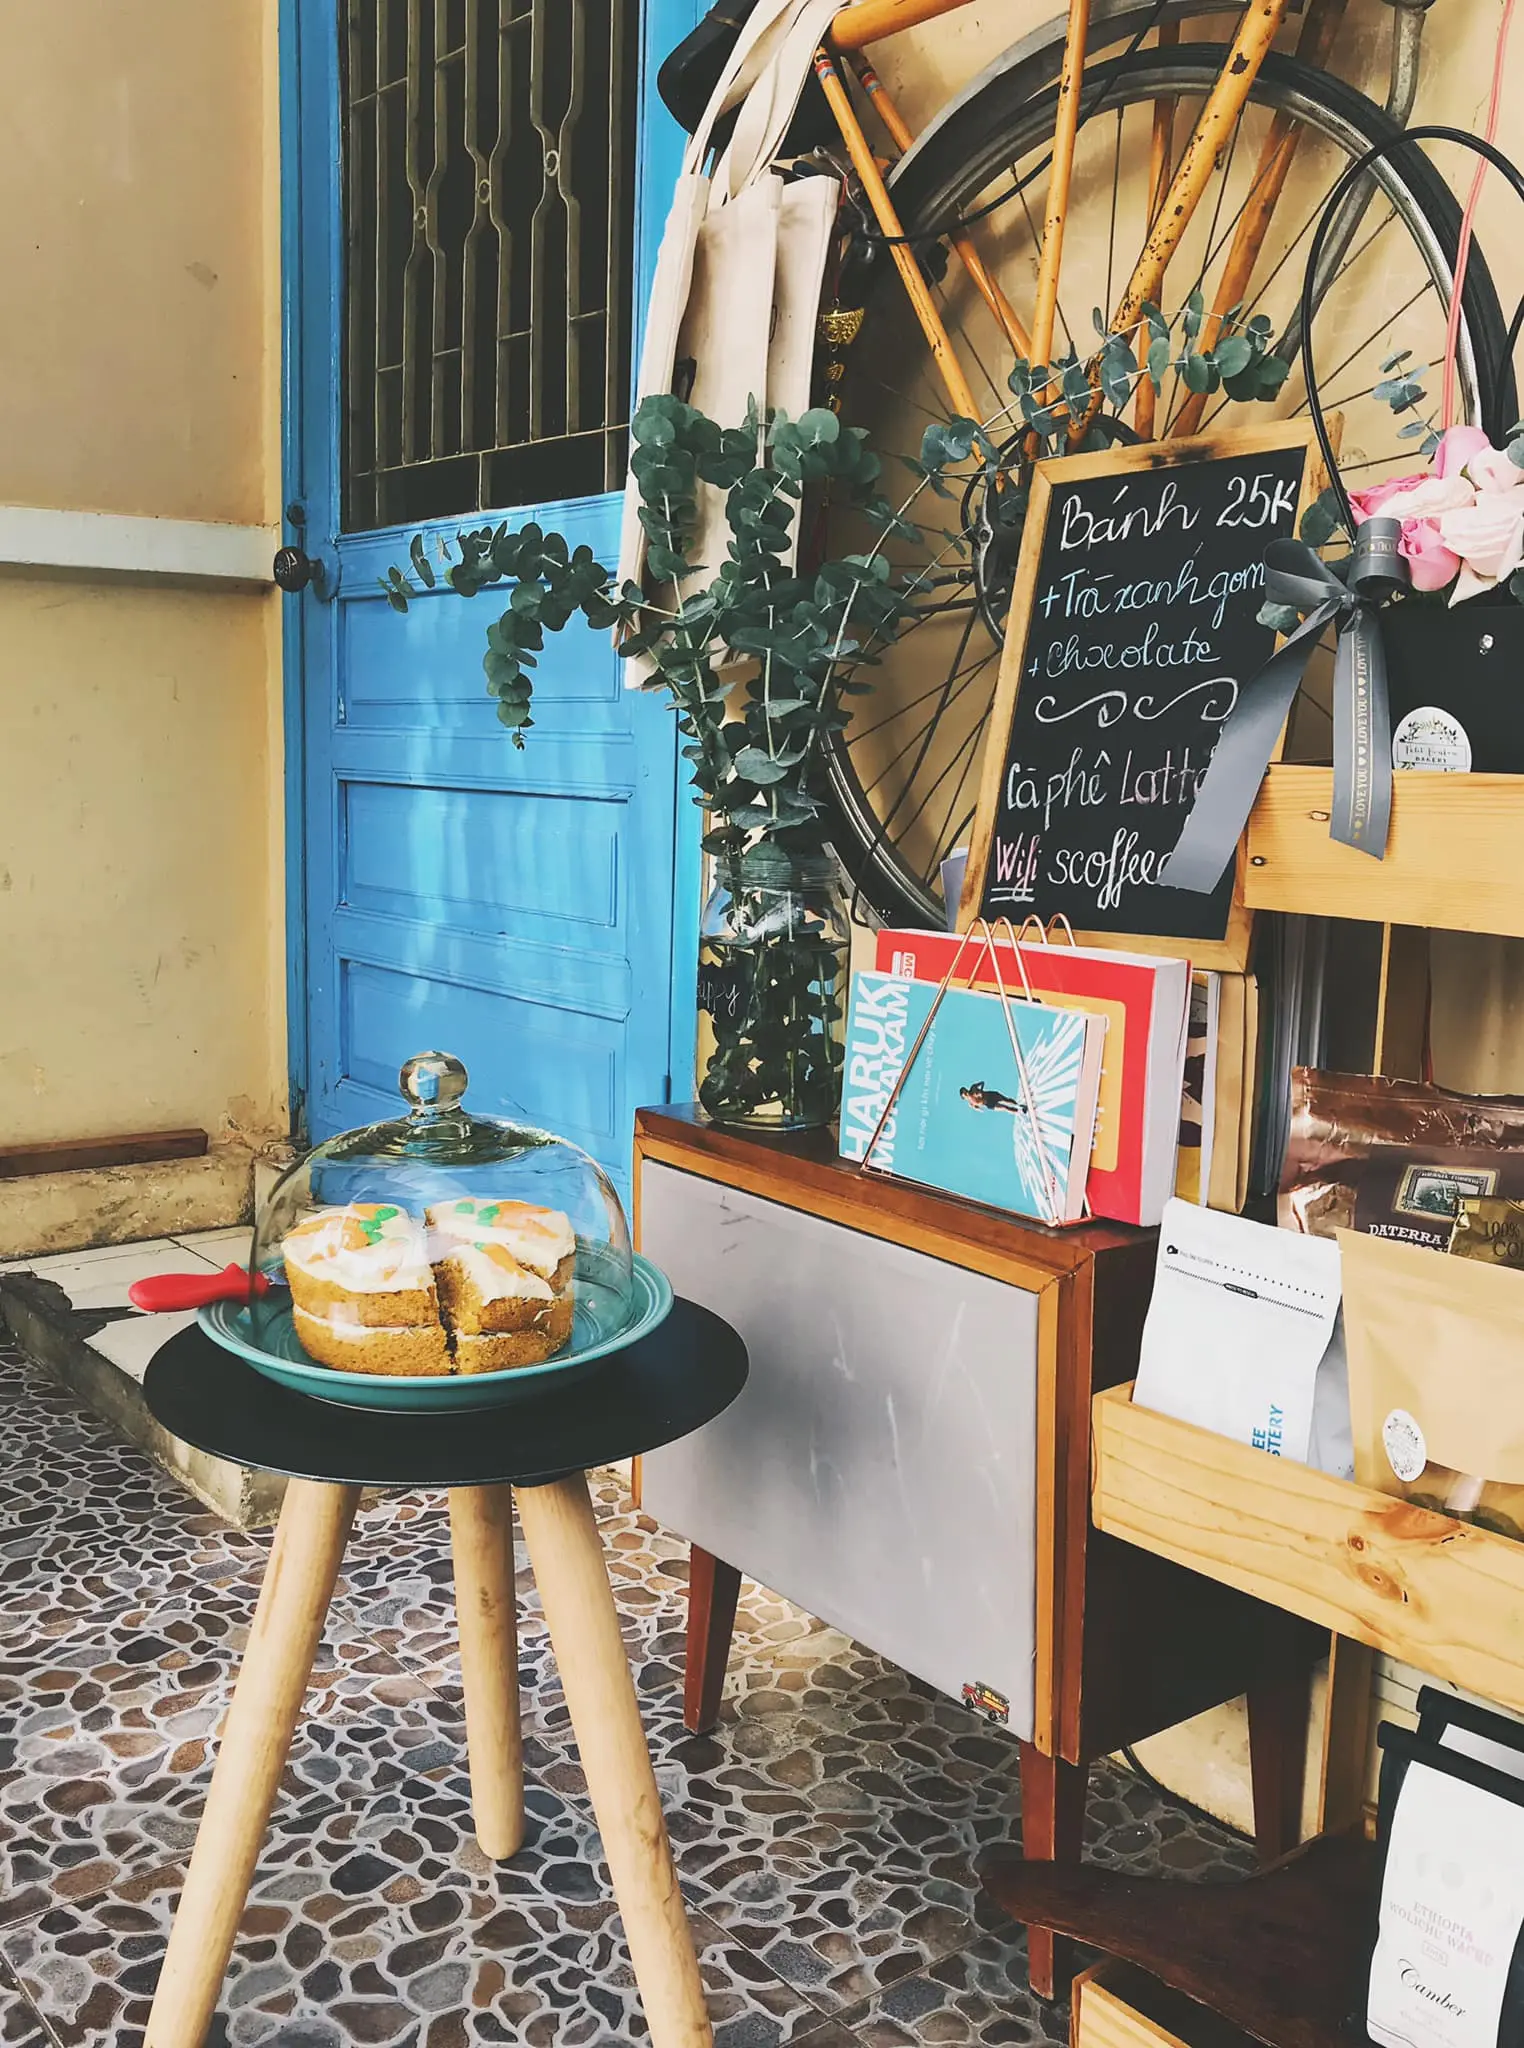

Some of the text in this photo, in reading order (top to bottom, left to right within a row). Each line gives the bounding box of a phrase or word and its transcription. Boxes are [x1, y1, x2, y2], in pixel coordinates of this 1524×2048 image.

[1060, 473, 1297, 551] Bánh 25K
[1358, 697, 1369, 746] LOVE YOU
[1355, 767, 1368, 818] LOVE YOU
[1047, 826, 1174, 910] scoffee
[1368, 1224, 1442, 1245] DATERRA
[1414, 1901, 1474, 1943] ETHIOPIA
[1397, 1958, 1467, 2018] Camber
